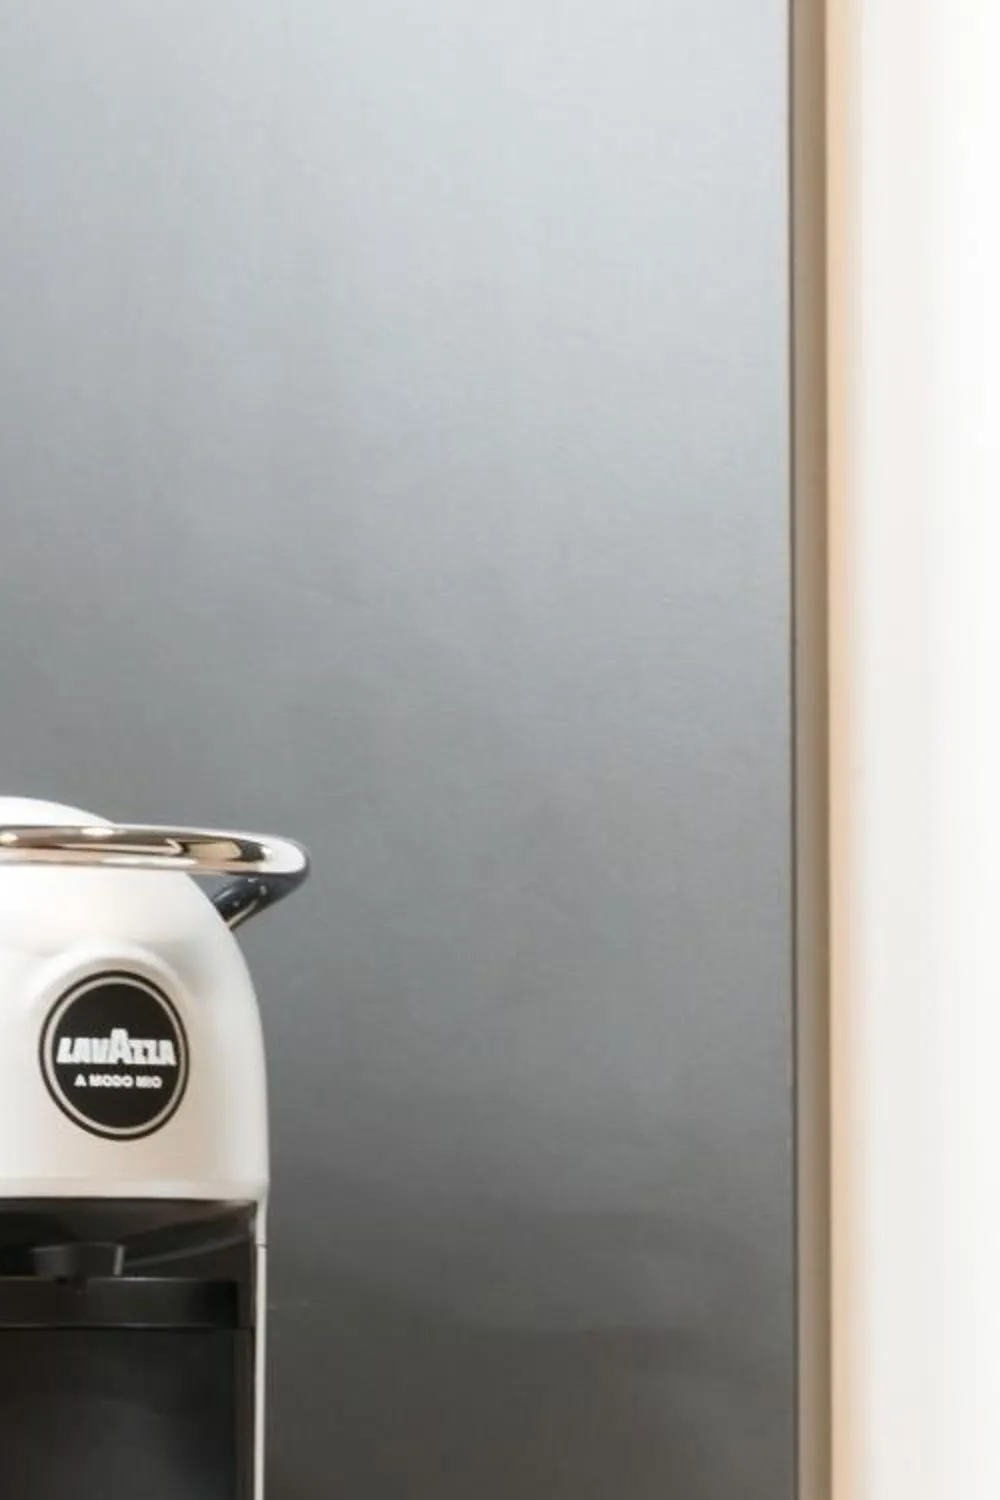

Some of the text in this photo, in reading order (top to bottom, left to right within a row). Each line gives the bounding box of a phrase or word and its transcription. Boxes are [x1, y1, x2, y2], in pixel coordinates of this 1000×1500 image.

[56, 1027, 177, 1066] LAVAZZA
[74, 1073, 163, 1089] A MODO MIO
